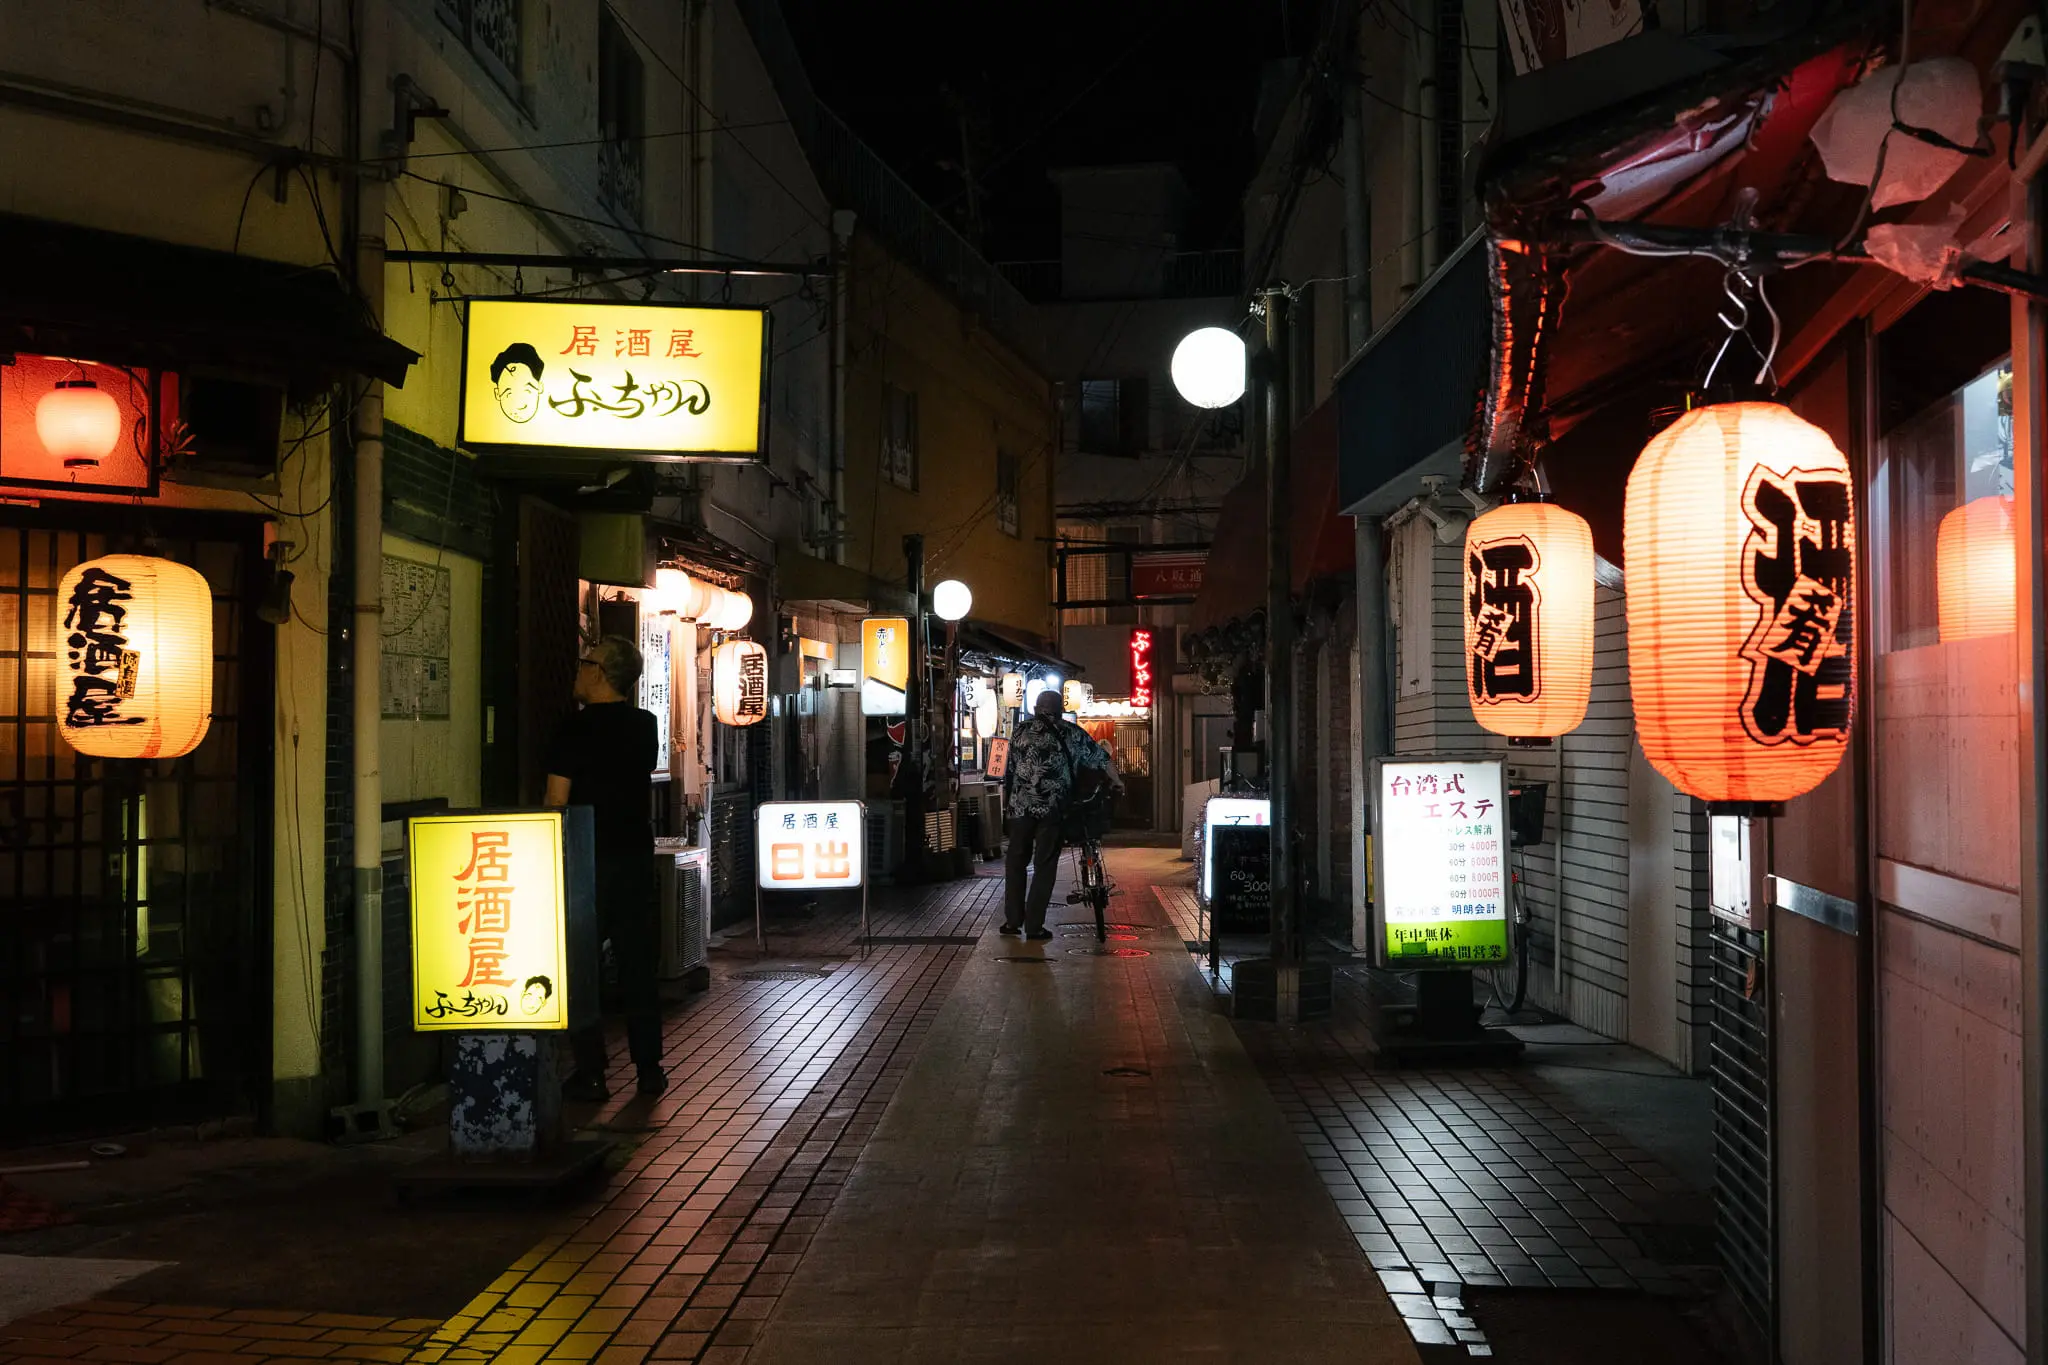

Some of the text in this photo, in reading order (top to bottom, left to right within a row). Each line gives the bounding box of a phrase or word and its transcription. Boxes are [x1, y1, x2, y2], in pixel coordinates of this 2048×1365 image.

[560, 325, 703, 358] 居酒屋
[64, 567, 149, 728] 居酒屋
[737, 652, 764, 716] 居酒屋
[992, 742, 1005, 775] 営業中
[1390, 773, 1465, 796] 台湾式
[782, 812, 840, 830] 居酒屋
[1422, 799, 1494, 819] エステ
[771, 840, 850, 880] 日出
[453, 832, 518, 988] 居酒屋
[1452, 903, 1496, 915] 明朗会計
